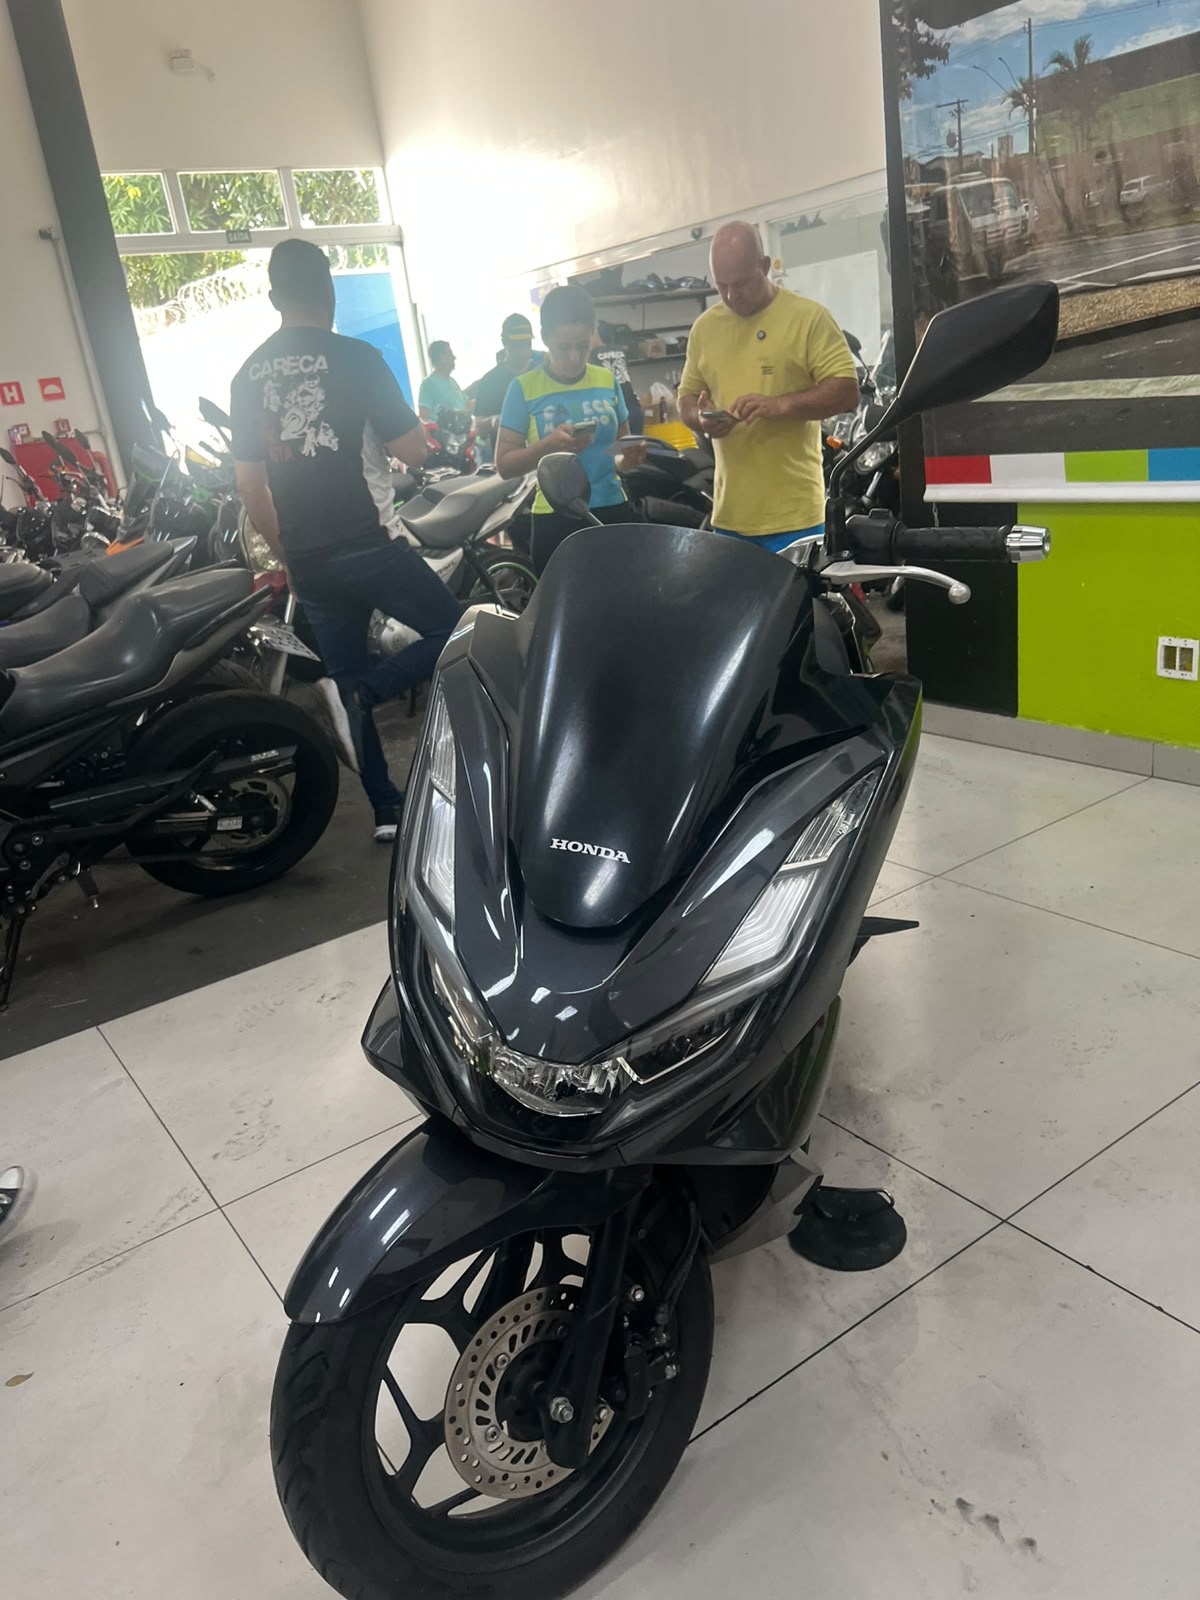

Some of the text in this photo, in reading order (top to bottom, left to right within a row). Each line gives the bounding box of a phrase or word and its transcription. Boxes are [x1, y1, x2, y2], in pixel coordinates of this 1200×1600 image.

[248, 354, 328, 380] CARECA
[3, 385, 20, 403] H
[550, 838, 631, 864] HONDA
